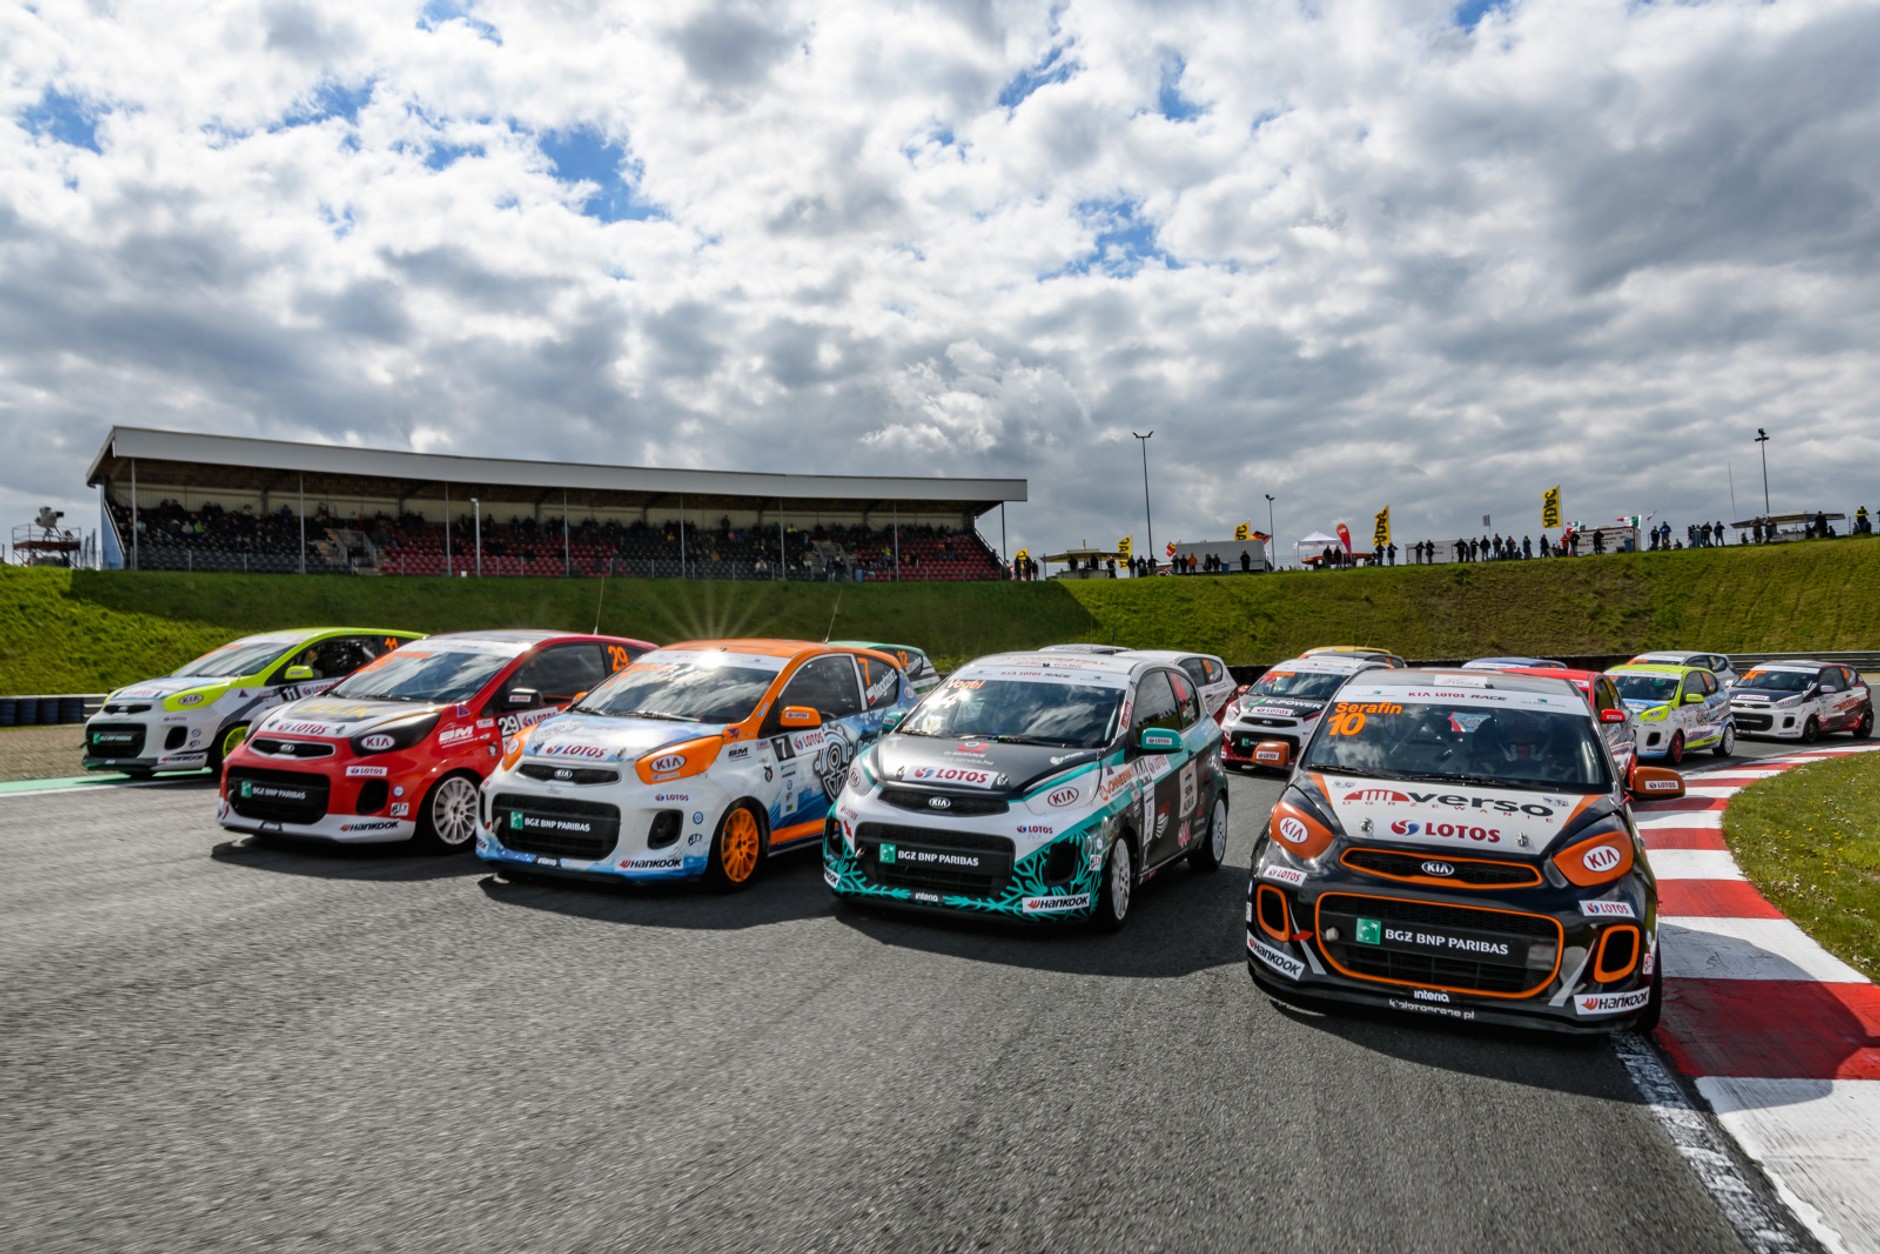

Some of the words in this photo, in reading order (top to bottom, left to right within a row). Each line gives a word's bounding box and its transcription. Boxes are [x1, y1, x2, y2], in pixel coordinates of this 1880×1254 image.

[608, 646, 629, 671] 29
[857, 658, 871, 686] 7
[283, 686, 298, 699] 11
[1470, 694, 1509, 702] RACE
[1336, 701, 1402, 717] Serafin
[292, 722, 330, 735] LOTOS
[498, 715, 519, 736] 29
[1327, 712, 1366, 737] 10
[366, 738, 390, 748] KIA
[802, 732, 825, 748] LOTOS
[563, 745, 607, 758] LOTOS
[776, 738, 787, 758] 7
[656, 756, 680, 770] KIA
[360, 768, 383, 776] LOTOS
[556, 769, 572, 778] KIA
[936, 768, 989, 783] LOTOS
[1657, 781, 1678, 790] LOTOS
[931, 798, 948, 807] KIA
[1053, 791, 1076, 804] KIA
[1408, 792, 1554, 816] verso
[524, 817, 540, 827] BGZ
[540, 818, 556, 829] BNP
[557, 821, 591, 833] PARIBAS
[1028, 825, 1053, 834] LOTOS
[1282, 819, 1307, 843] KIA
[1425, 822, 1500, 843] LOTOS
[898, 850, 917, 861] BGZ
[918, 851, 937, 861] BNP
[938, 854, 979, 866] PARIBAS
[1588, 848, 1618, 869] KIA
[1277, 867, 1302, 883] LOTOS
[1425, 863, 1452, 875] KIA
[1599, 902, 1630, 915] LOTOS
[1385, 929, 1413, 943] BGZ
[1416, 933, 1445, 947] BNP
[1448, 937, 1509, 955] PARIBAS
